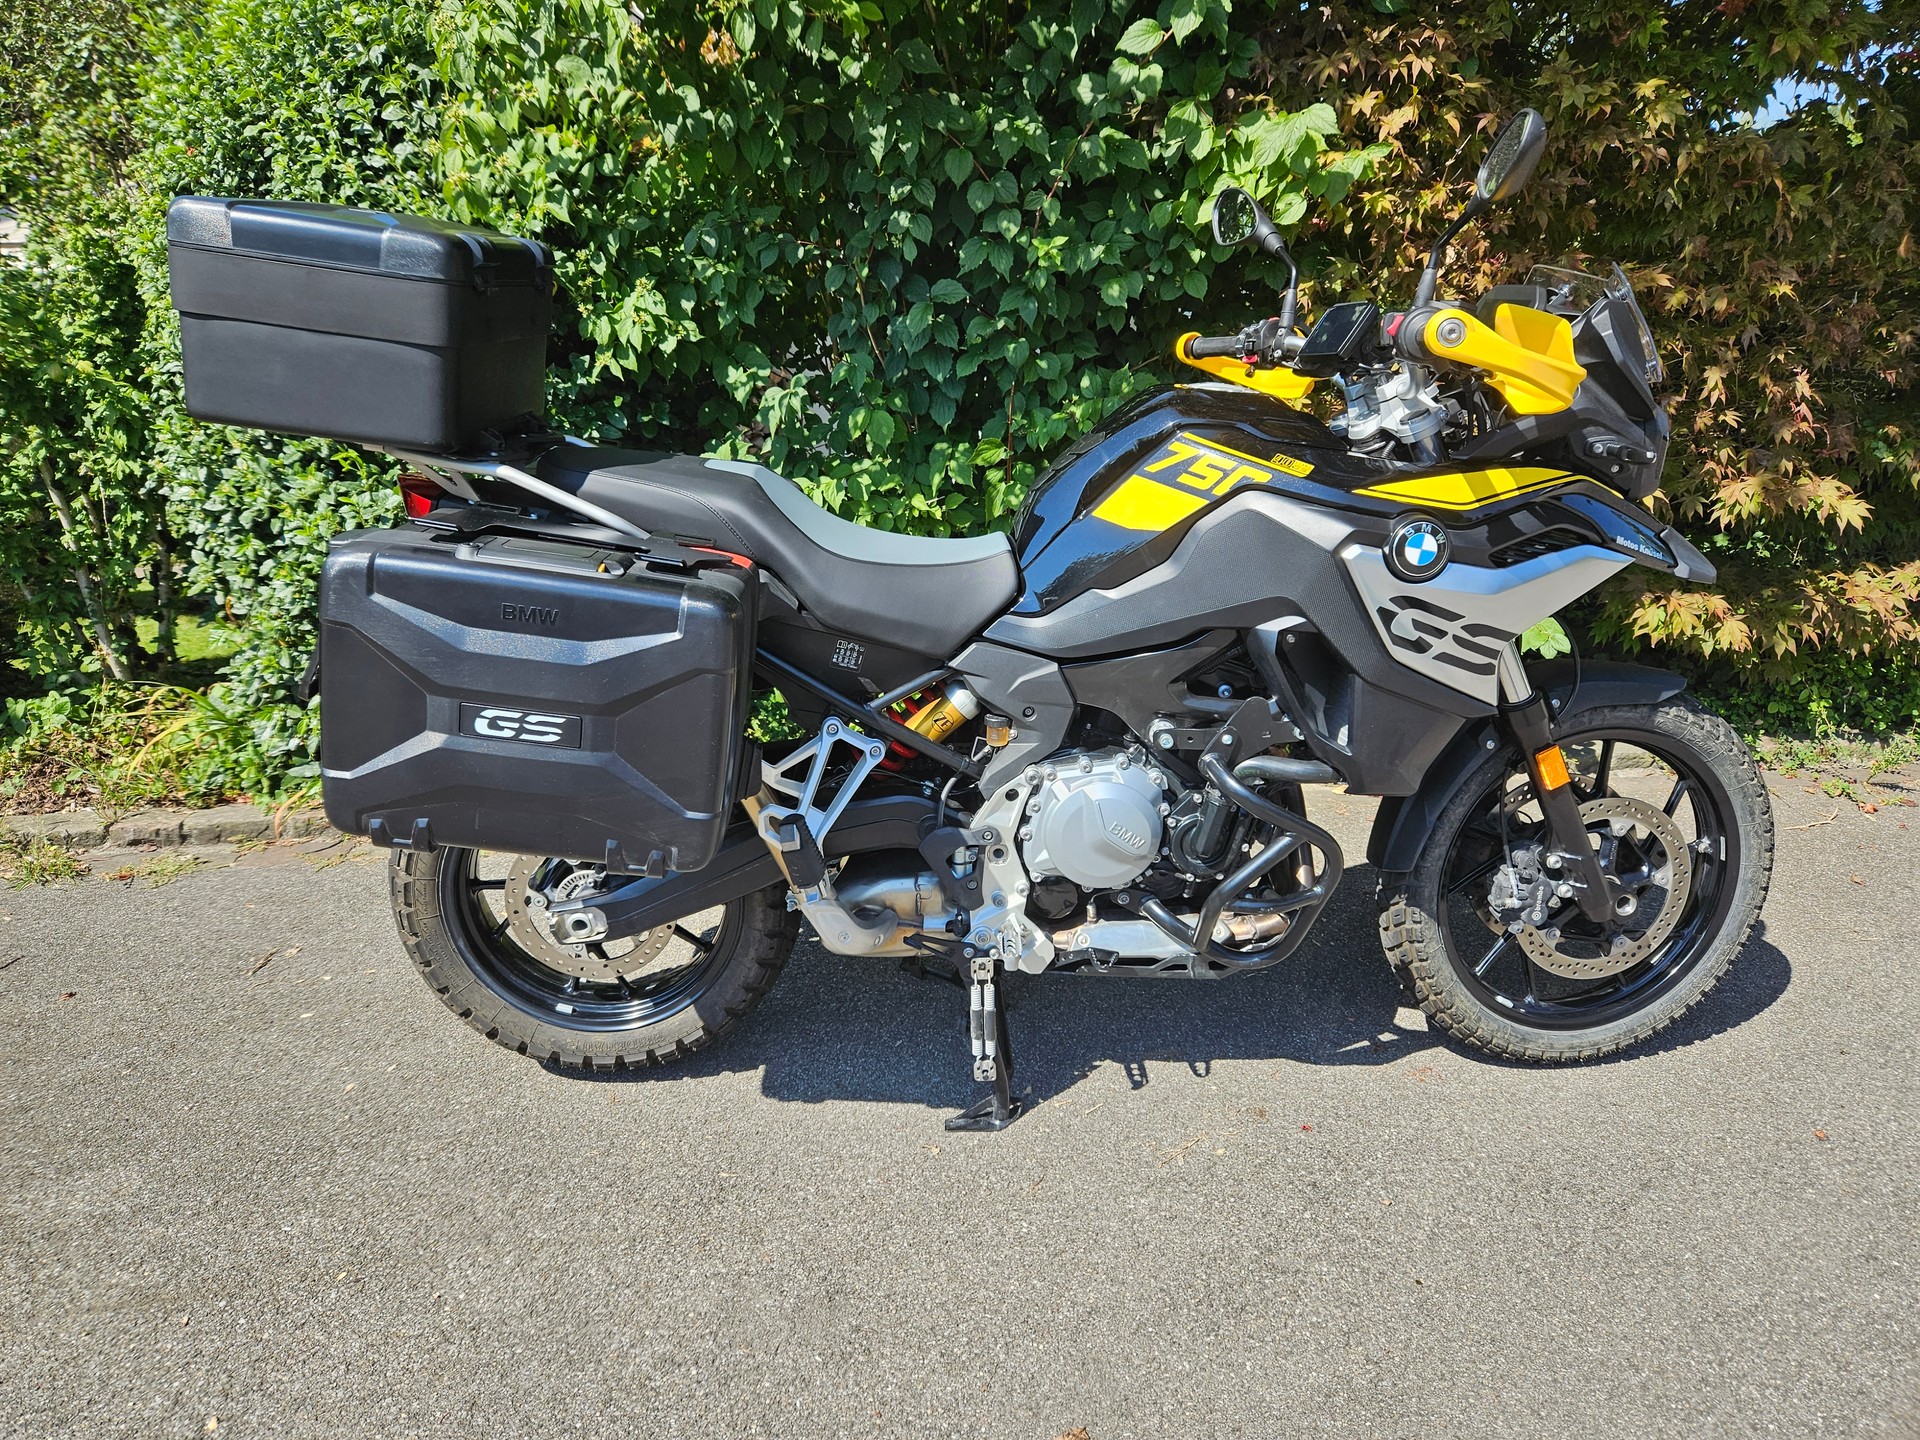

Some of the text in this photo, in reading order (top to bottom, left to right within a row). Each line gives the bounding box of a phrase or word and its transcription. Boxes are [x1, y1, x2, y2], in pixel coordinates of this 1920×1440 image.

[1403, 523, 1446, 545] BMW
[1616, 535, 1639, 551] Motos
[501, 602, 560, 626] BMW
[1376, 595, 1519, 676] GS
[474, 709, 567, 742] GS
[932, 711, 953, 732] ZF
[1109, 820, 1147, 849] BMW
[1534, 886, 1544, 911] brembo
